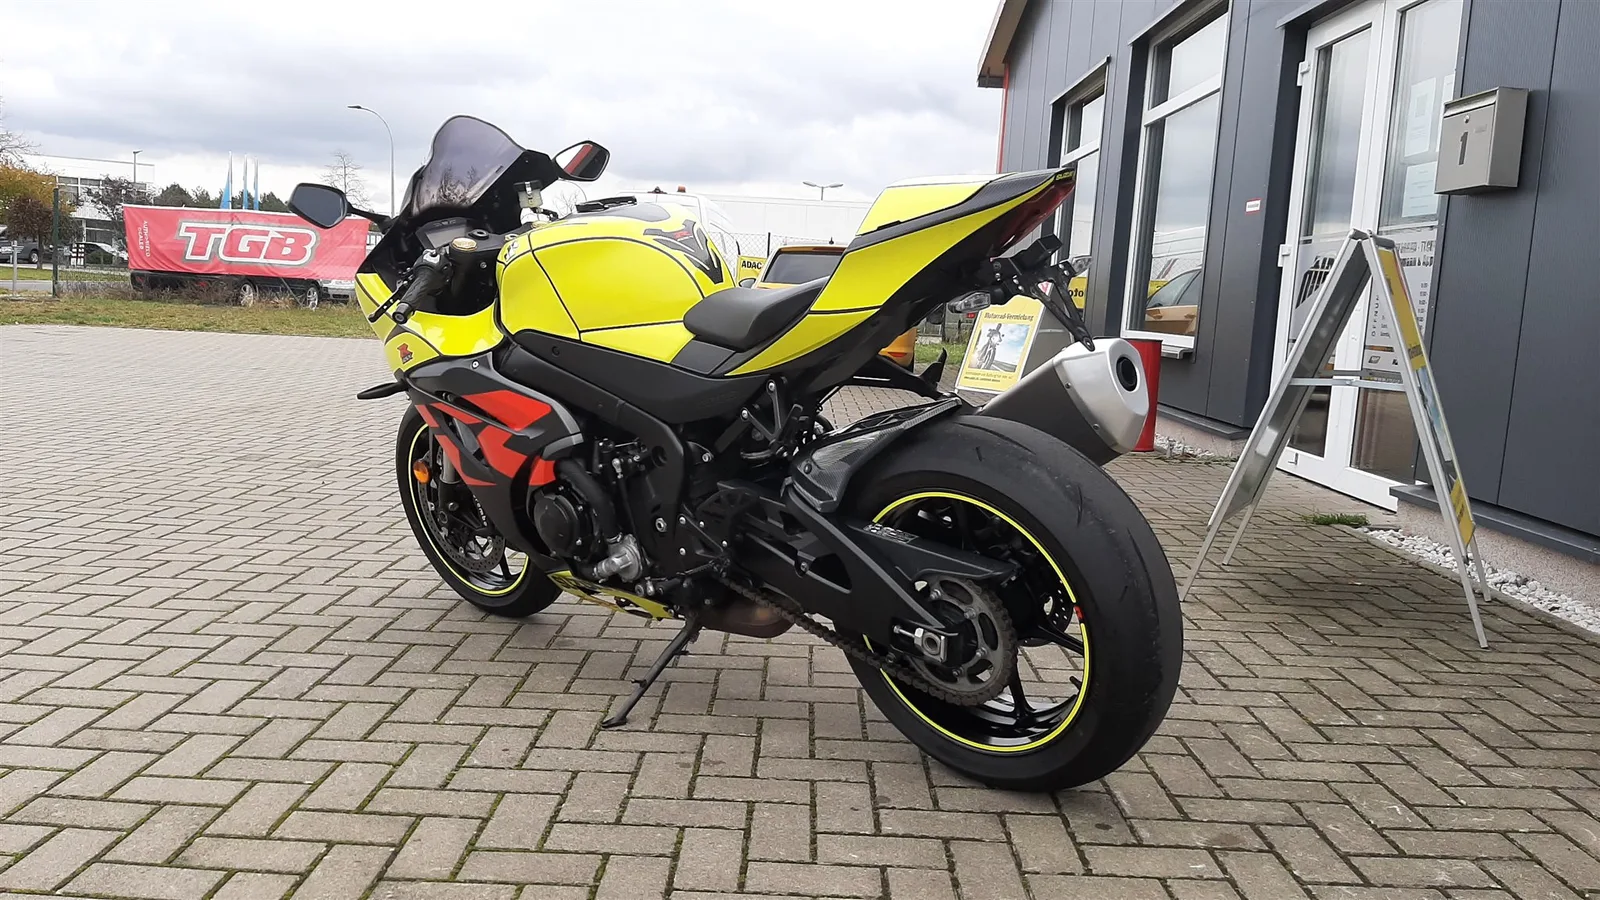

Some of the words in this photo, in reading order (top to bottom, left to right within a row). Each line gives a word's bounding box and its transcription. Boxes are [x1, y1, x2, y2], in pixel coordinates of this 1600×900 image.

[1459, 131, 1468, 165] 1
[178, 221, 317, 266] TGB
[741, 260, 762, 270] ADAC
[1069, 288, 1084, 297] oto
